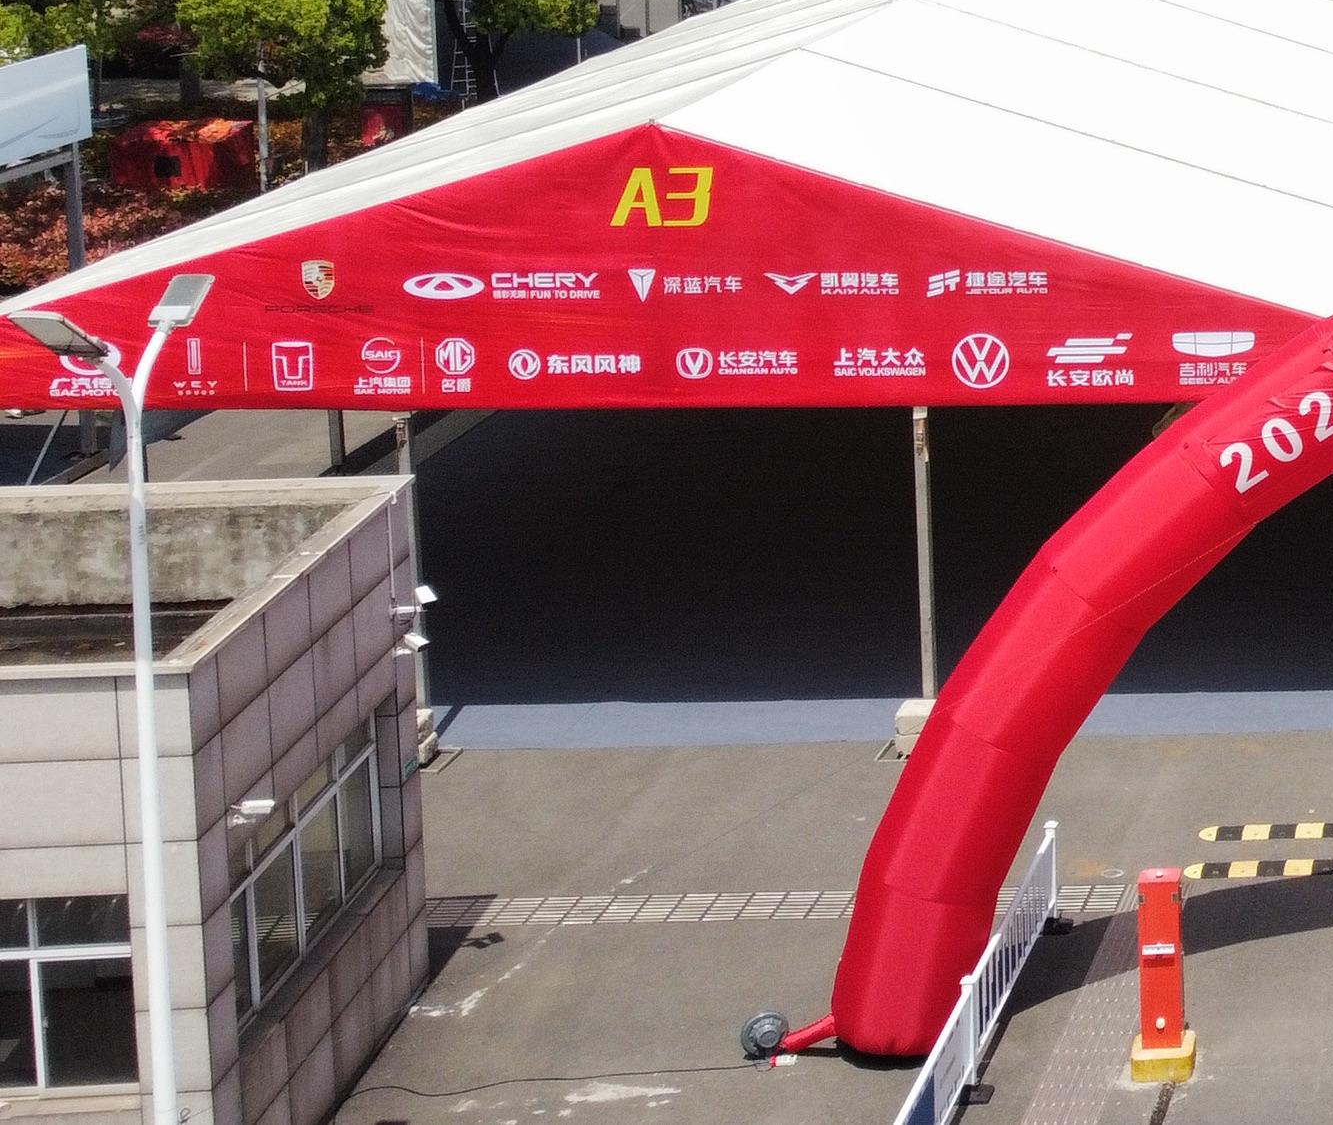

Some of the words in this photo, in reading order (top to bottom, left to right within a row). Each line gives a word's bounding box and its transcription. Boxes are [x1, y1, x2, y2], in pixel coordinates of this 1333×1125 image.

[610, 167, 714, 227] A3
[491, 272, 599, 288] CHERY
[663, 276, 743, 294] 深蓝汽车
[820, 272, 899, 287] 凯翼汽车
[964, 271, 1048, 287] 捷途汽车
[530, 290, 551, 299] FUN
[569, 290, 600, 299] DRIVE
[265, 305, 374, 313] PORSCHE
[546, 354, 641, 374] 东风风神
[717, 350, 798, 367] 长安汽车
[833, 347, 925, 367] 上汽大众
[834, 367, 858, 376] SAIC
[858, 367, 926, 376] VOLKSWAGEN
[1179, 361, 1248, 376] 吉利汽车
[49, 377, 132, 390] 广汽传
[172, 380, 218, 388] WEY
[280, 379, 308, 387] TANK
[354, 377, 411, 388] 上汽集团
[1046, 369, 1134, 386] 长安欧尚
[441, 378, 472, 393] 名爵
